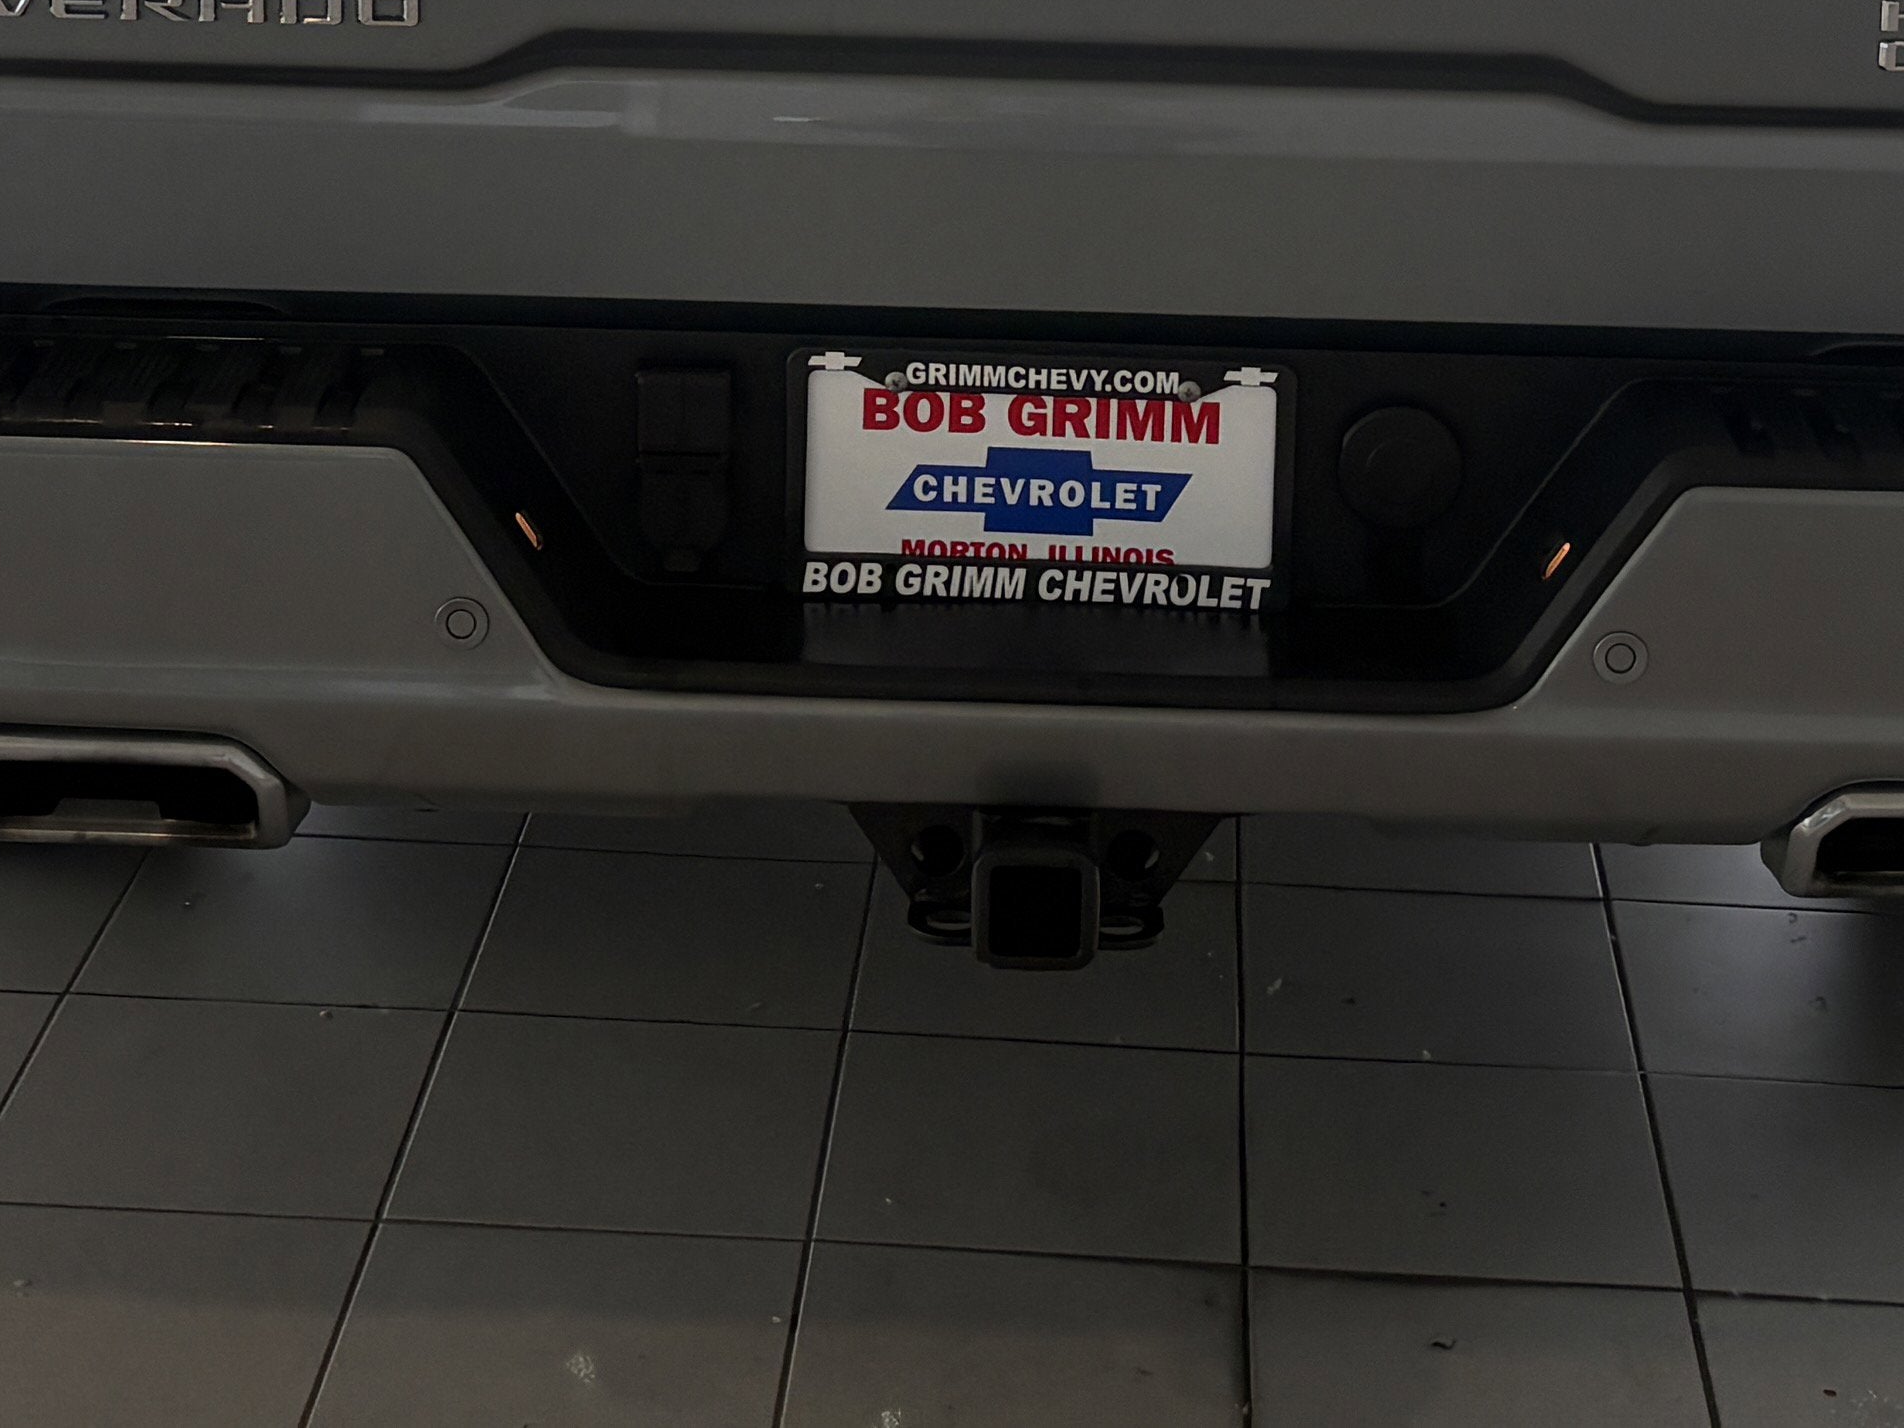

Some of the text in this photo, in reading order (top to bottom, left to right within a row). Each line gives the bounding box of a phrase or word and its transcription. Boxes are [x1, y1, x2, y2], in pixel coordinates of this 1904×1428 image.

[906, 362, 1180, 394] GRIMMCHEVY.COM
[862, 388, 1220, 445] BOB GRIMM
[913, 474, 1162, 512] CHEVROLET
[802, 561, 1271, 610] BOB GRIMM CHEVROLET
